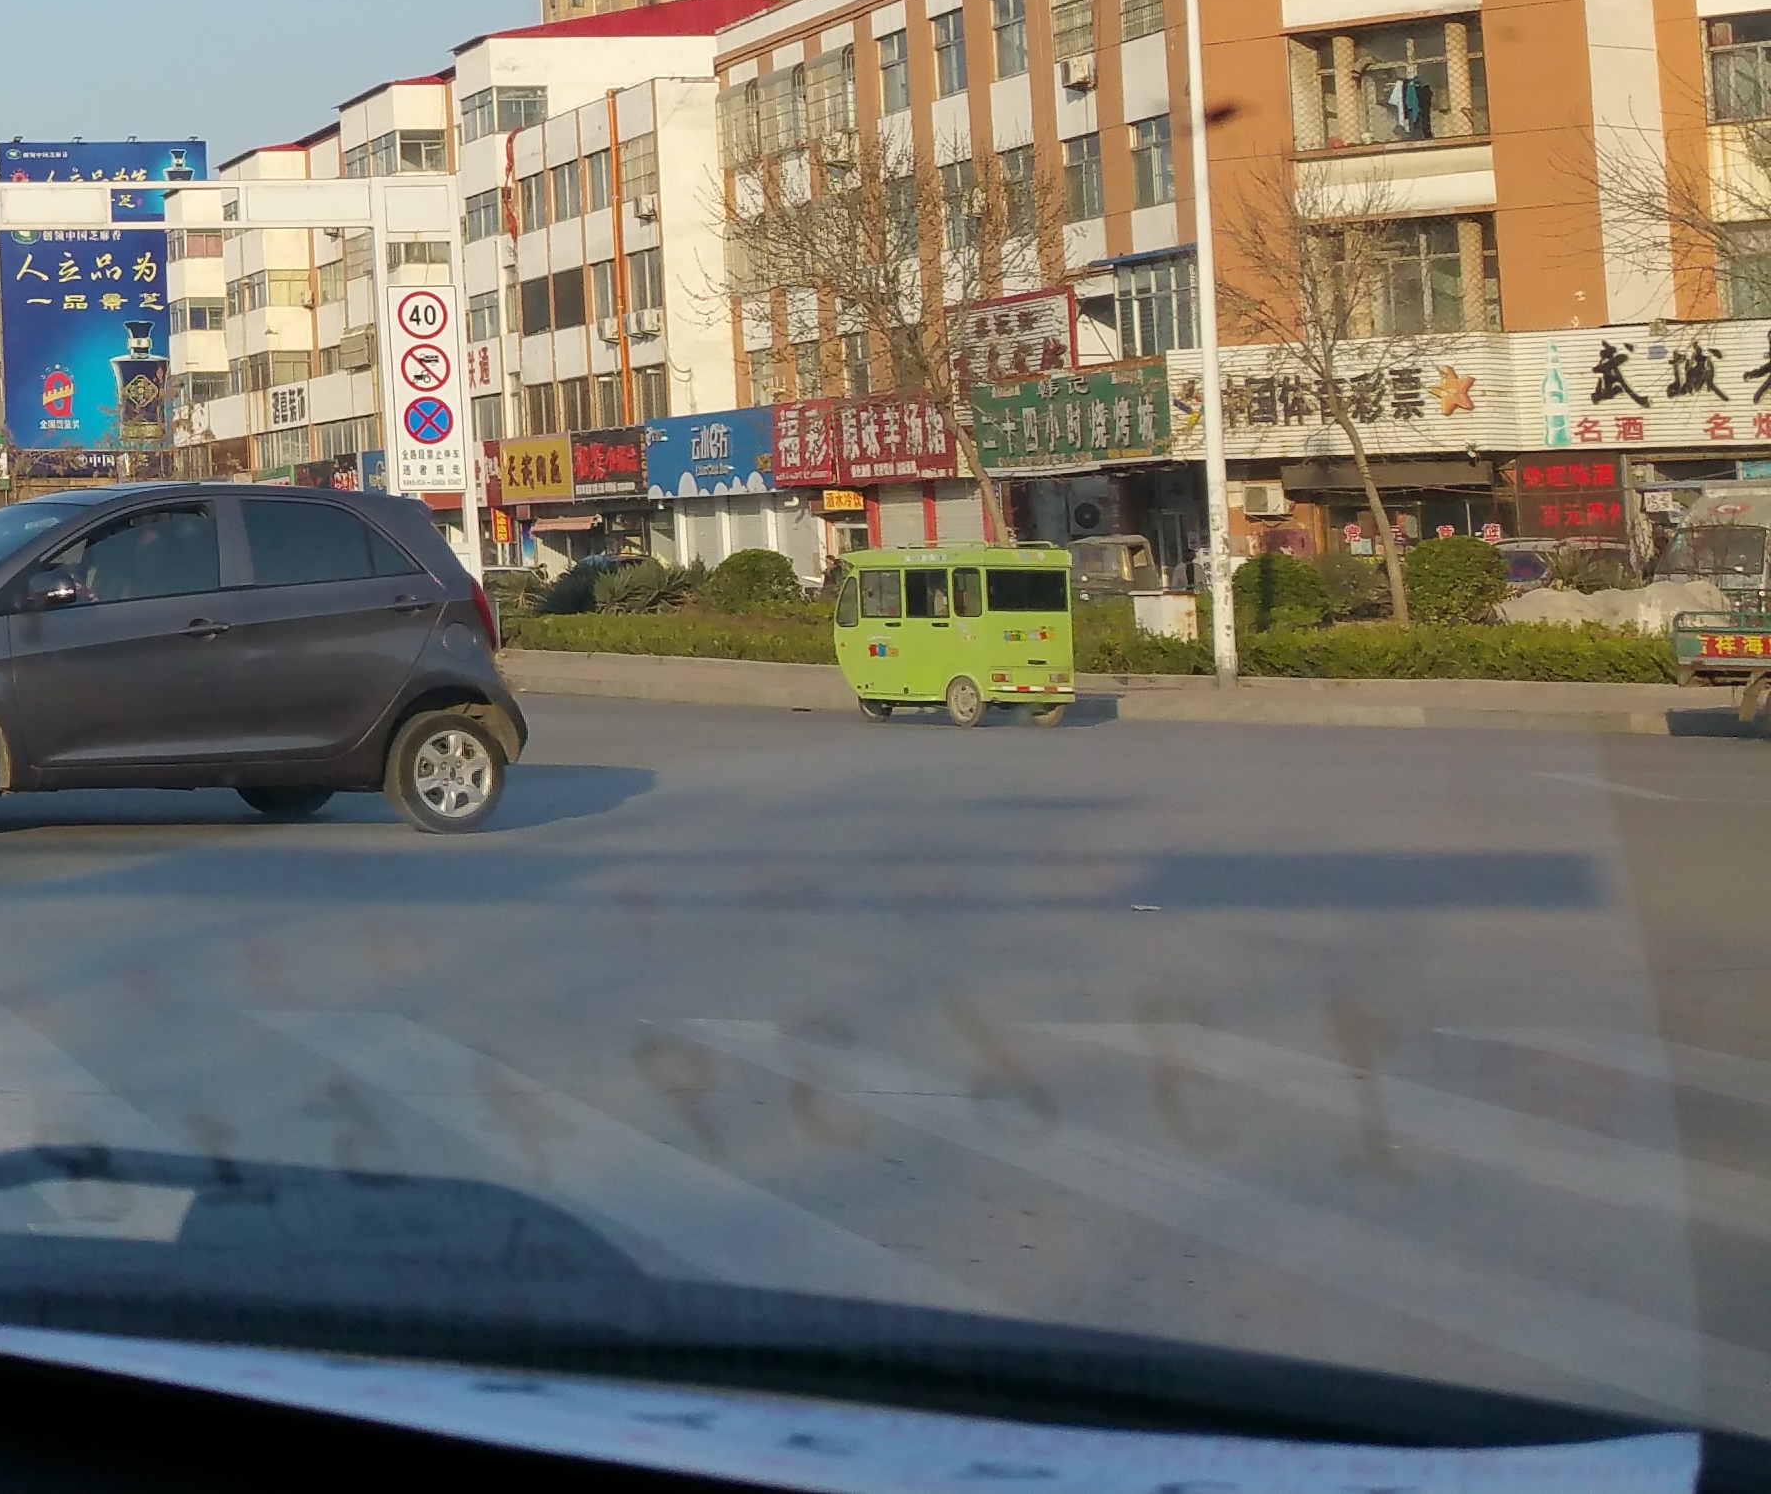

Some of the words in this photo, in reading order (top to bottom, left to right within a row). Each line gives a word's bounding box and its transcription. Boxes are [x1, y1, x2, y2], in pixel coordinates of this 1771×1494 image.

[16, 251, 157, 283] 人立品为
[26, 292, 165, 312] 一品景芝
[408, 304, 437, 326] 40
[1222, 368, 1426, 427] 中国体育彩票
[778, 405, 828, 468] 福彩
[1574, 416, 1645, 443] 名酒
